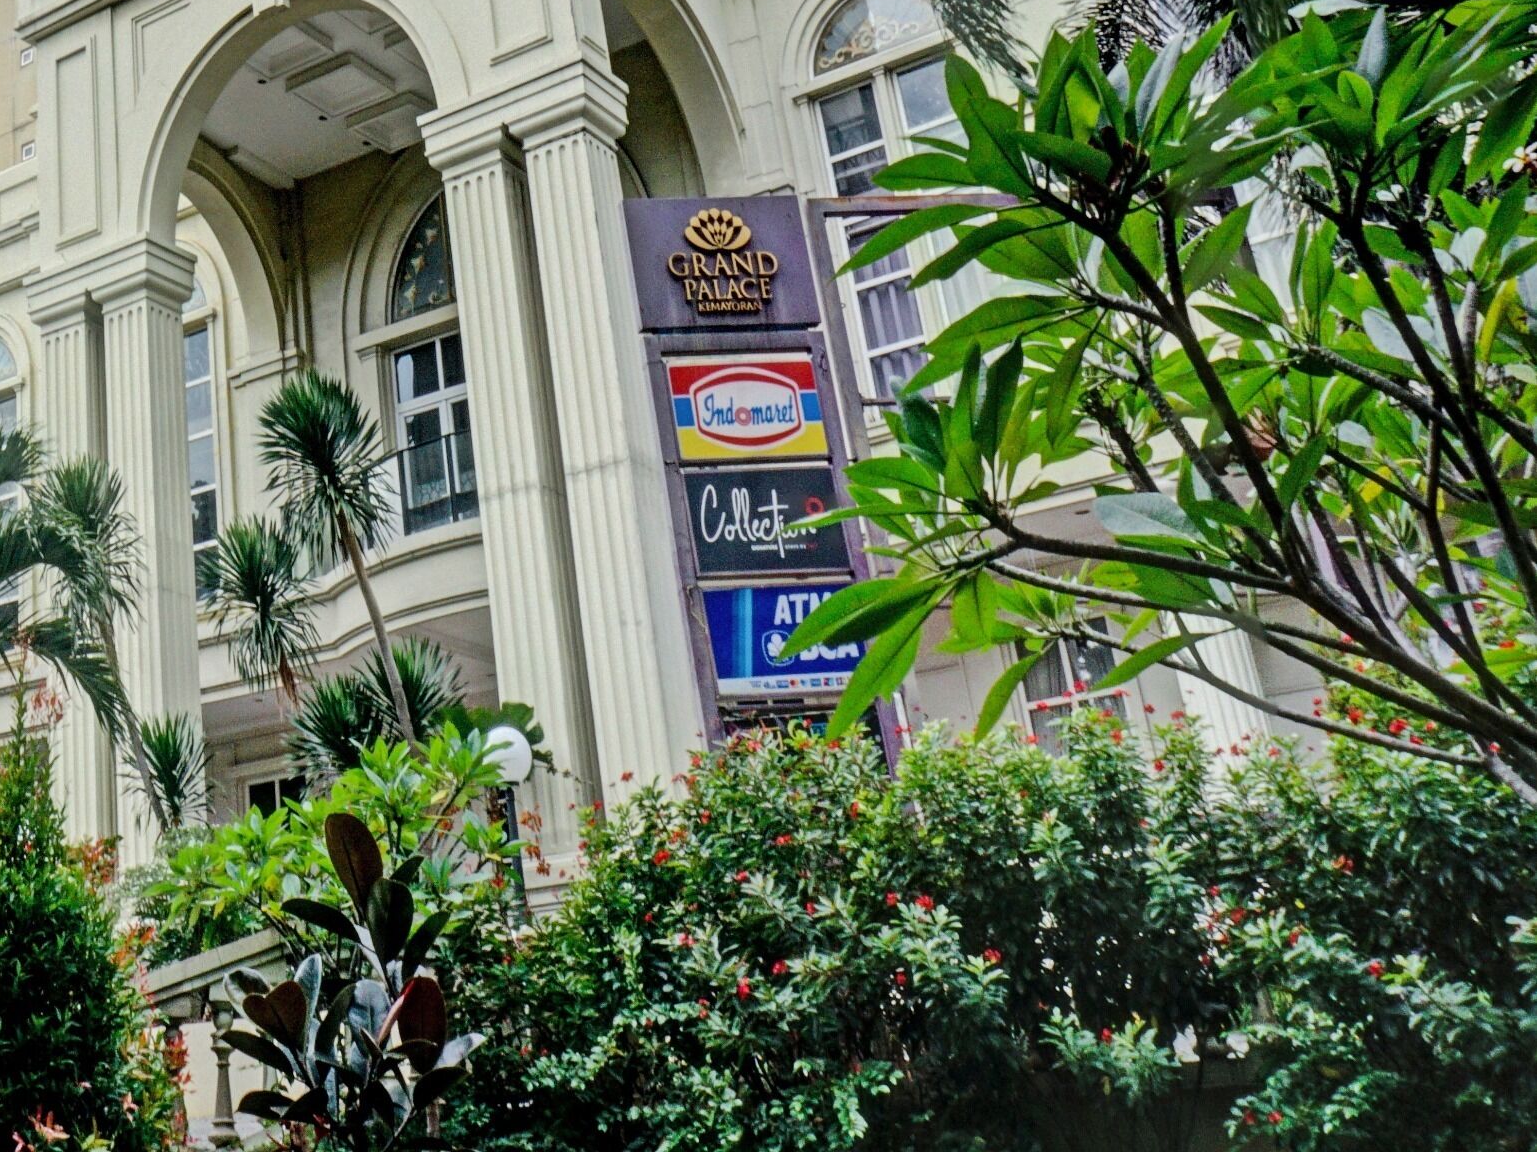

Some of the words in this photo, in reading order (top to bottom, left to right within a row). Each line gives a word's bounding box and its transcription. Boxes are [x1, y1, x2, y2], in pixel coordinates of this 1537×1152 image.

[668, 251, 779, 277] GRAND
[684, 278, 773, 301] PALACE
[698, 301, 762, 312] KEMAYORAN
[702, 394, 795, 427] Indomaret
